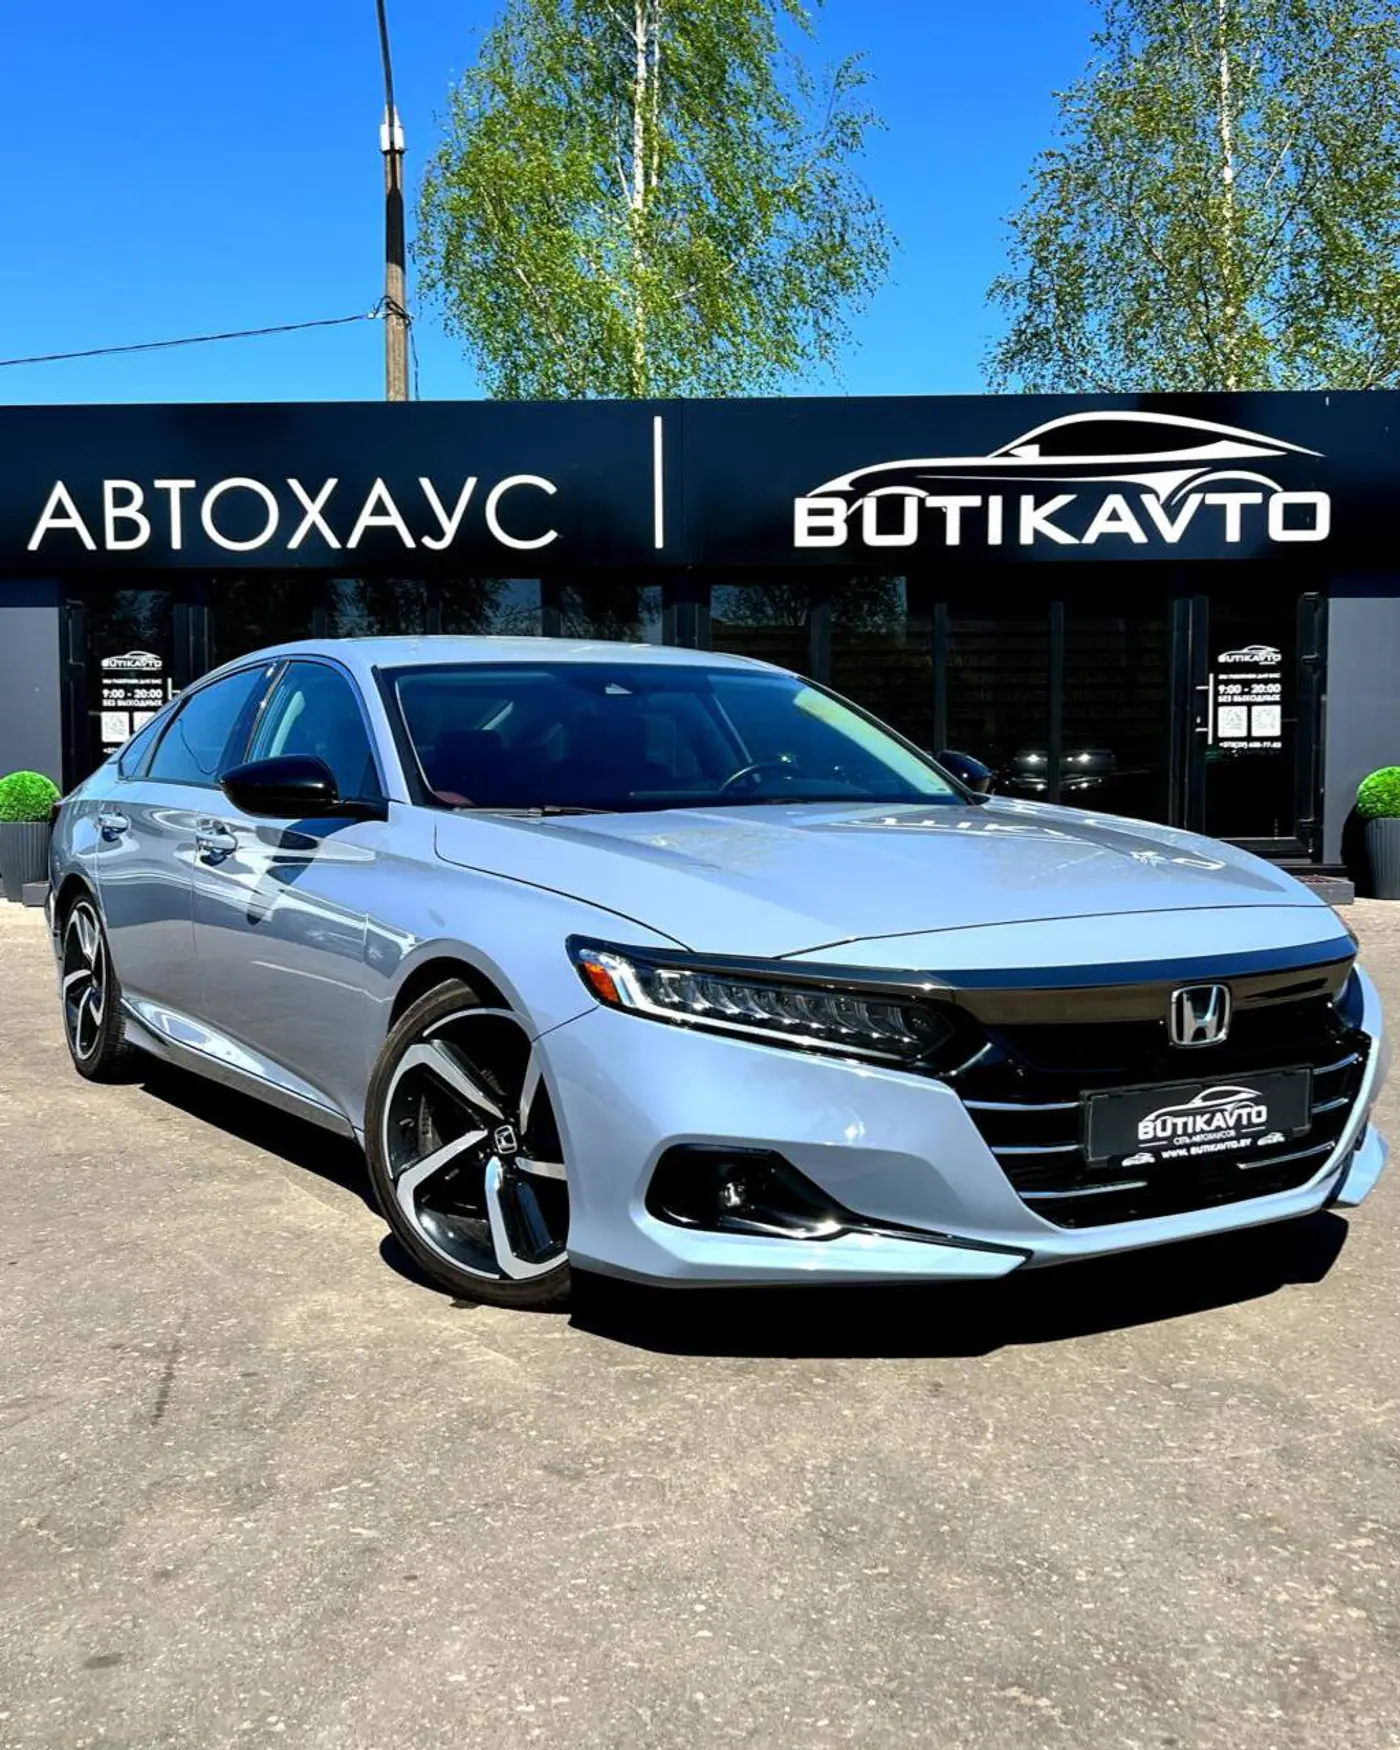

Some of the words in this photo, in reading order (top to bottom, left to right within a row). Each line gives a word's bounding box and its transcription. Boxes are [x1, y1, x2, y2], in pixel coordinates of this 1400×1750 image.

[26, 475, 559, 552] АВТОХАУС
[793, 490, 1332, 548] BUTIKAVTO
[101, 659, 162, 668] BUTIKAVTO
[133, 689, 163, 698] 20:00
[1251, 684, 1281, 694] 20:00
[1138, 1105, 1268, 1140] BUTIKAVTO
